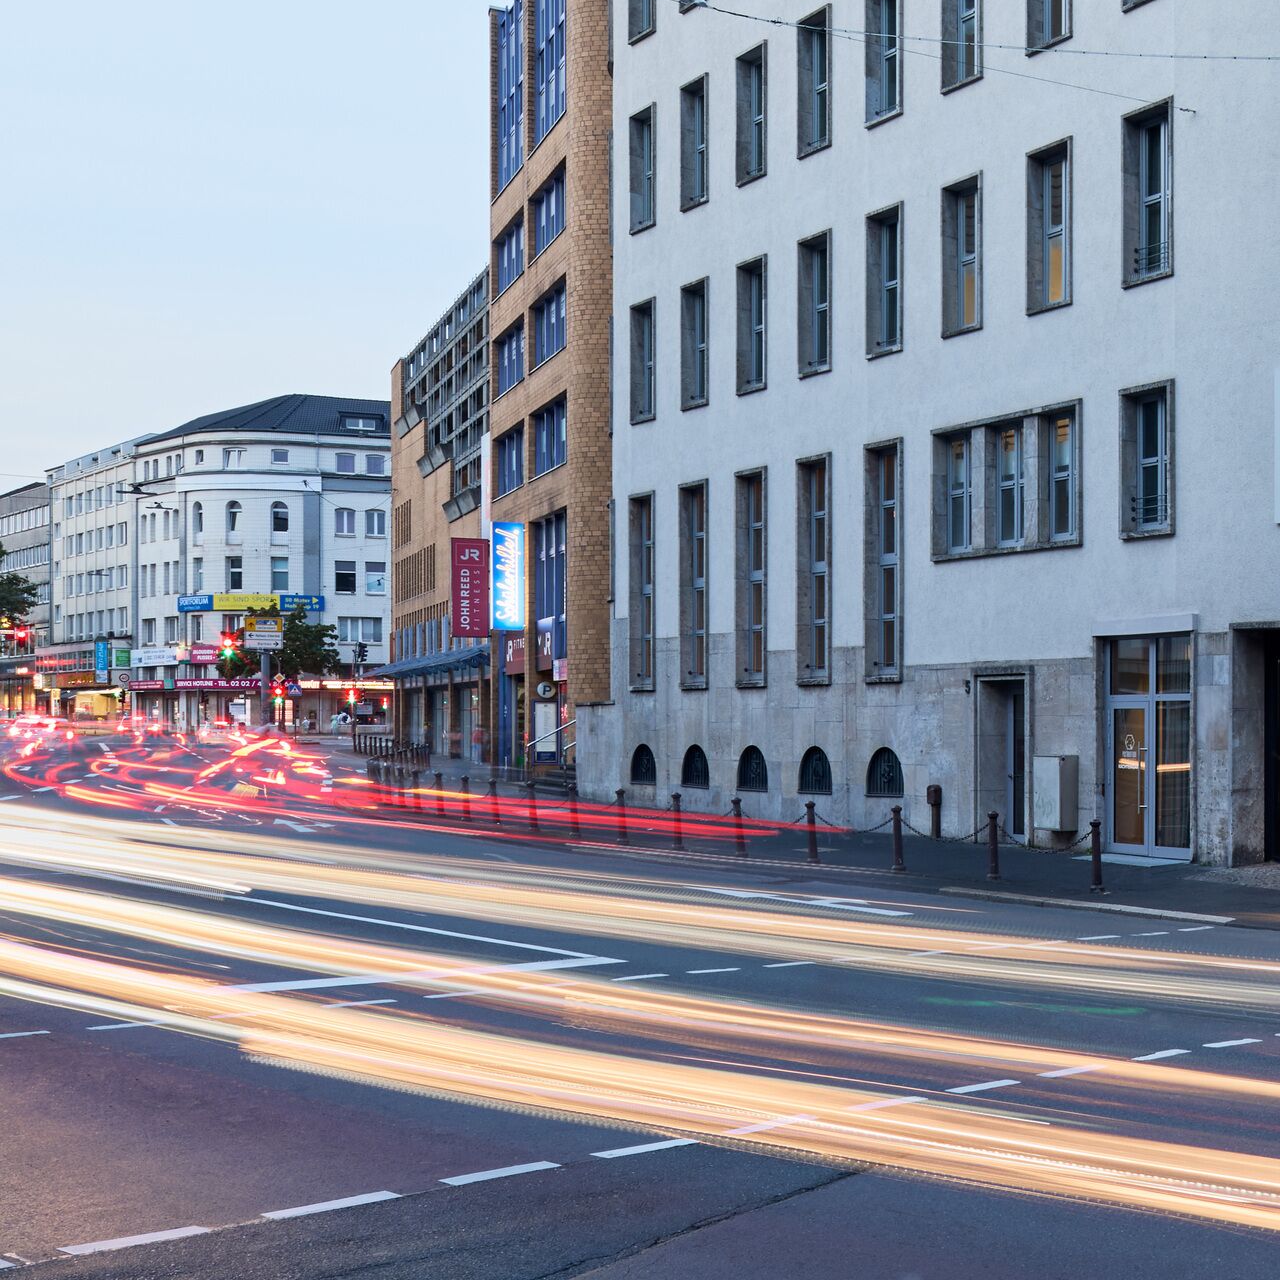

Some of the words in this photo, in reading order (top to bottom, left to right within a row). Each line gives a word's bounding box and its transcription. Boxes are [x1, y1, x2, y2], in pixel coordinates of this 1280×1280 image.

[460, 548, 480, 561] JR
[460, 569, 470, 597] REED
[473, 569, 481, 631] FITNESS
[460, 600, 470, 630] JOHN
[542, 685, 552, 695] P
